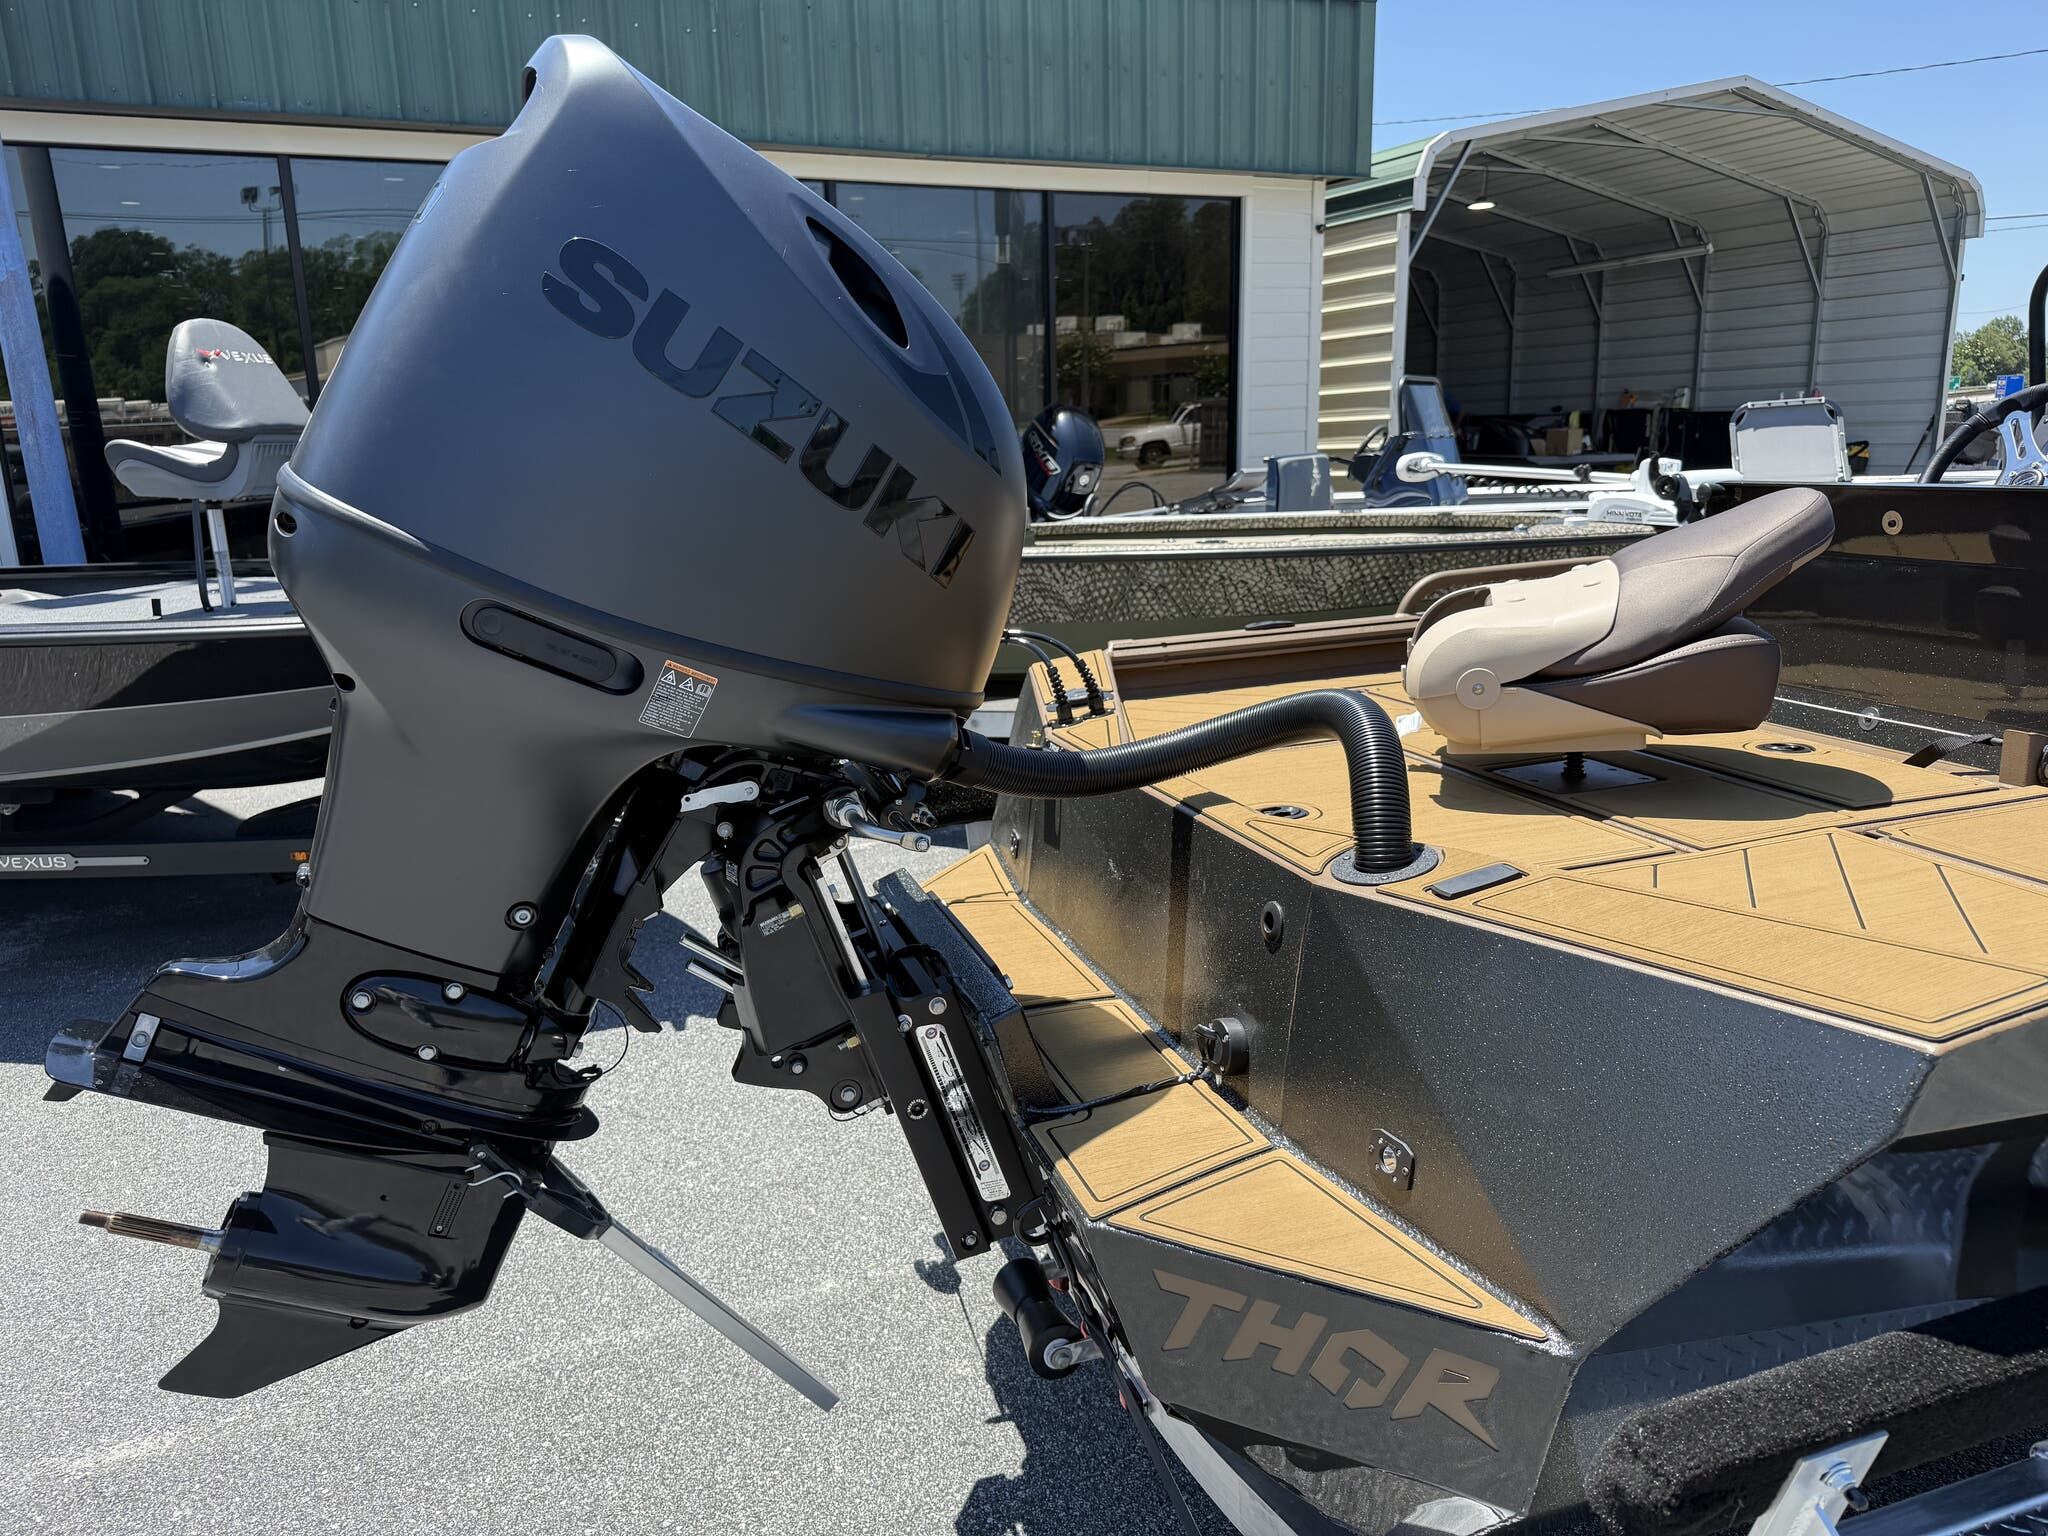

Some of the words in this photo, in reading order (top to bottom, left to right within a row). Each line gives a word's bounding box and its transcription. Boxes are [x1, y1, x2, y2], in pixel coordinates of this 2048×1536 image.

[541, 236, 976, 589] SUZUKI
[0, 856, 67, 870] VEXUS
[1153, 1268, 1500, 1452] THOR
